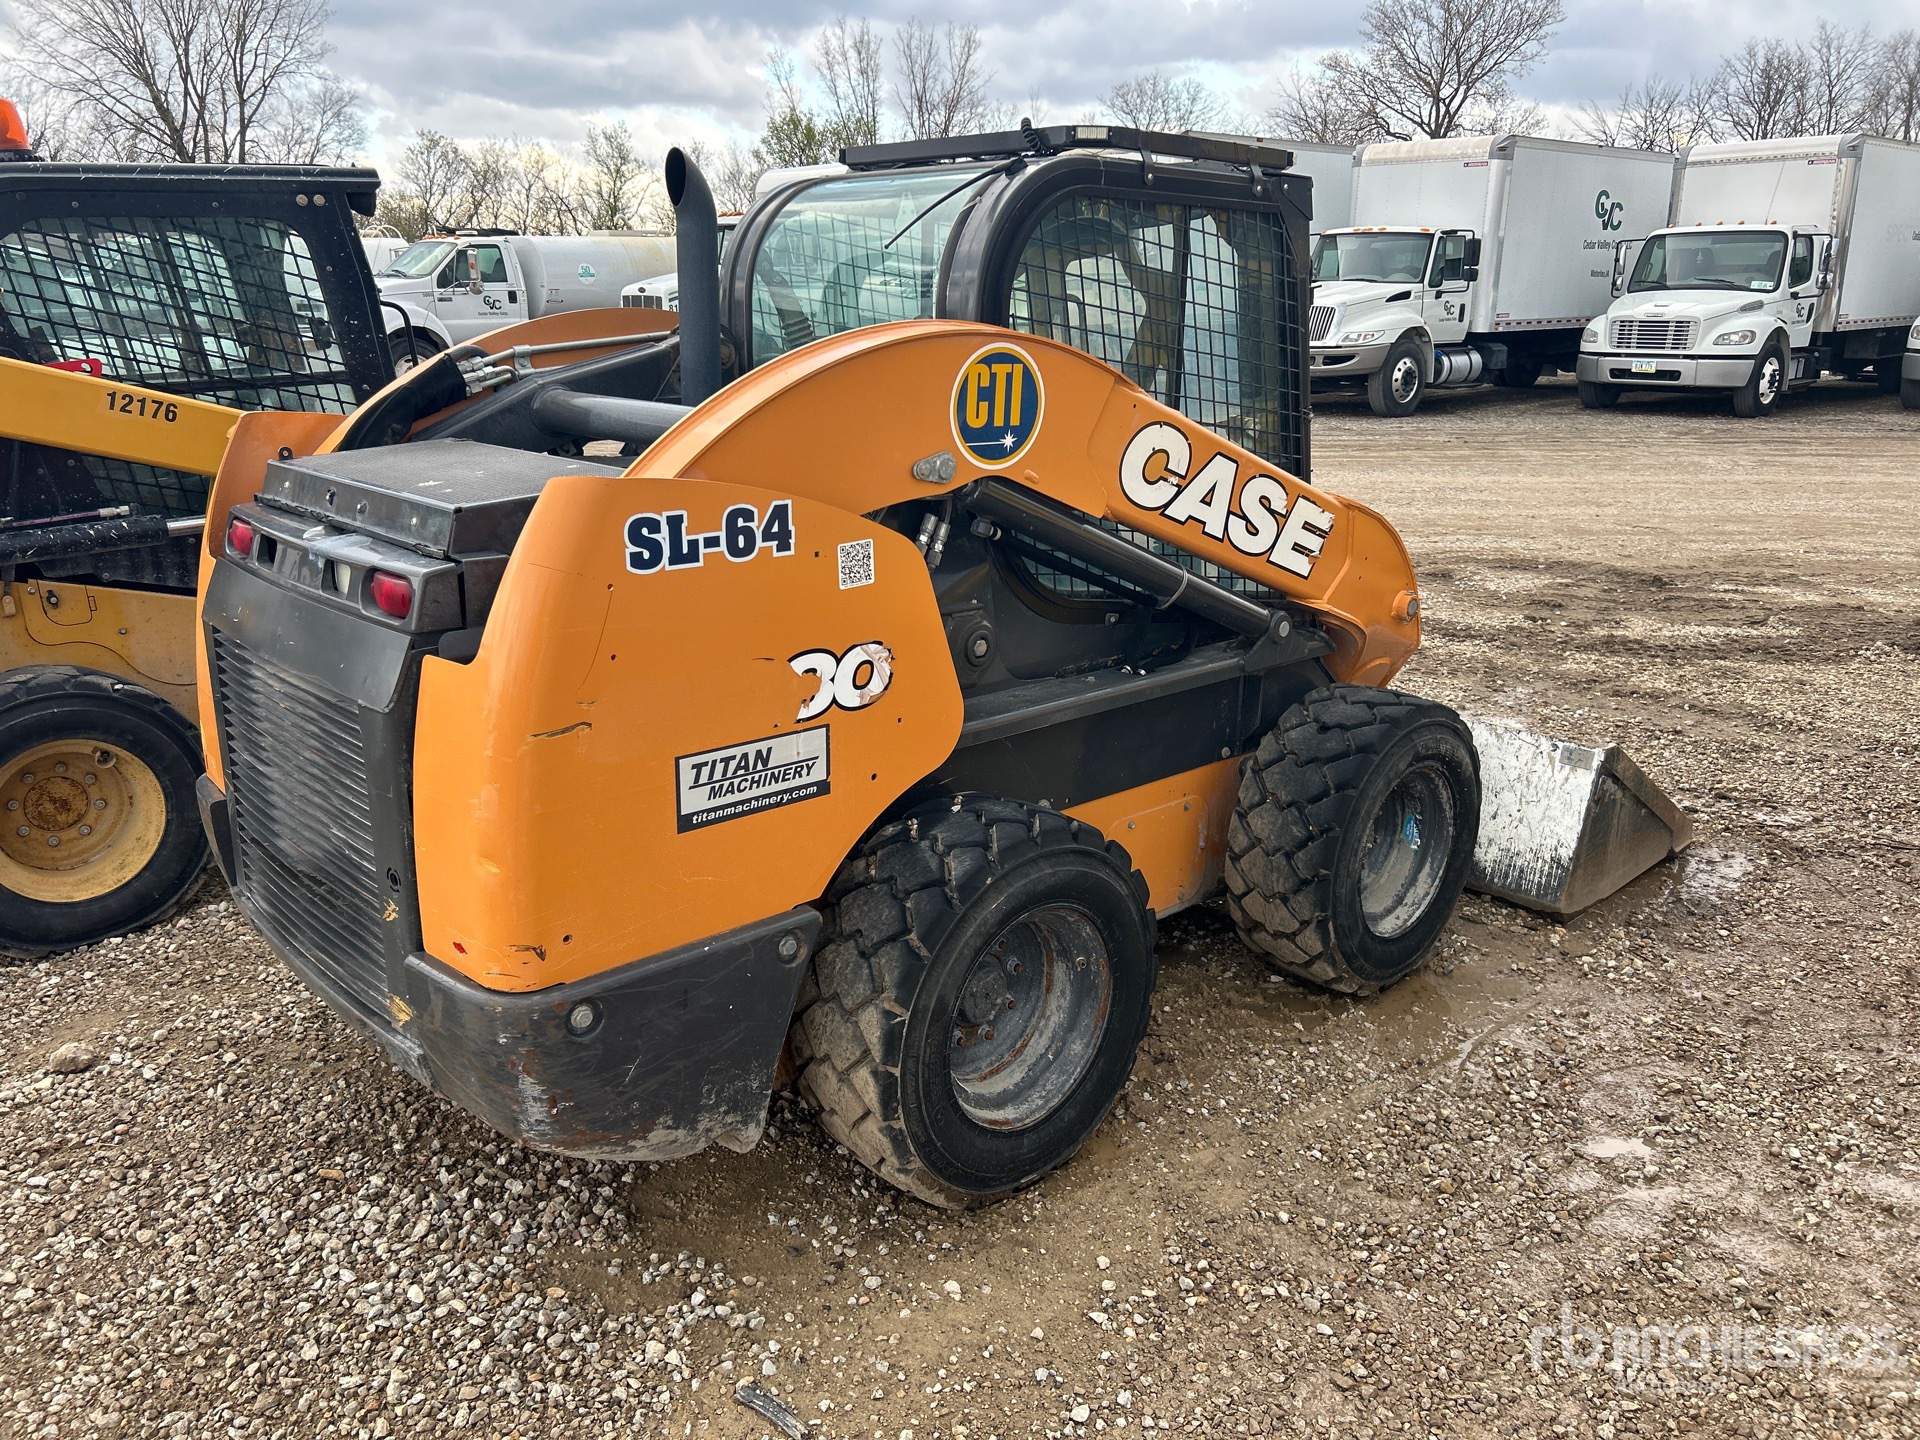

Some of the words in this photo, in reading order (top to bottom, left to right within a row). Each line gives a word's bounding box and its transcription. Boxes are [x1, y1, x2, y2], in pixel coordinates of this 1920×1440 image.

[1595, 189, 1624, 231] CVC
[483, 295, 502, 310] CVC
[107, 391, 179, 422] 12176
[966, 363, 1024, 429] CTI
[1119, 420, 1335, 580] CASE
[624, 500, 795, 574] SL-64
[691, 746, 773, 785] TITAN
[707, 760, 817, 801] MACHINERY
[692, 785, 818, 824] titanmachinery.com
